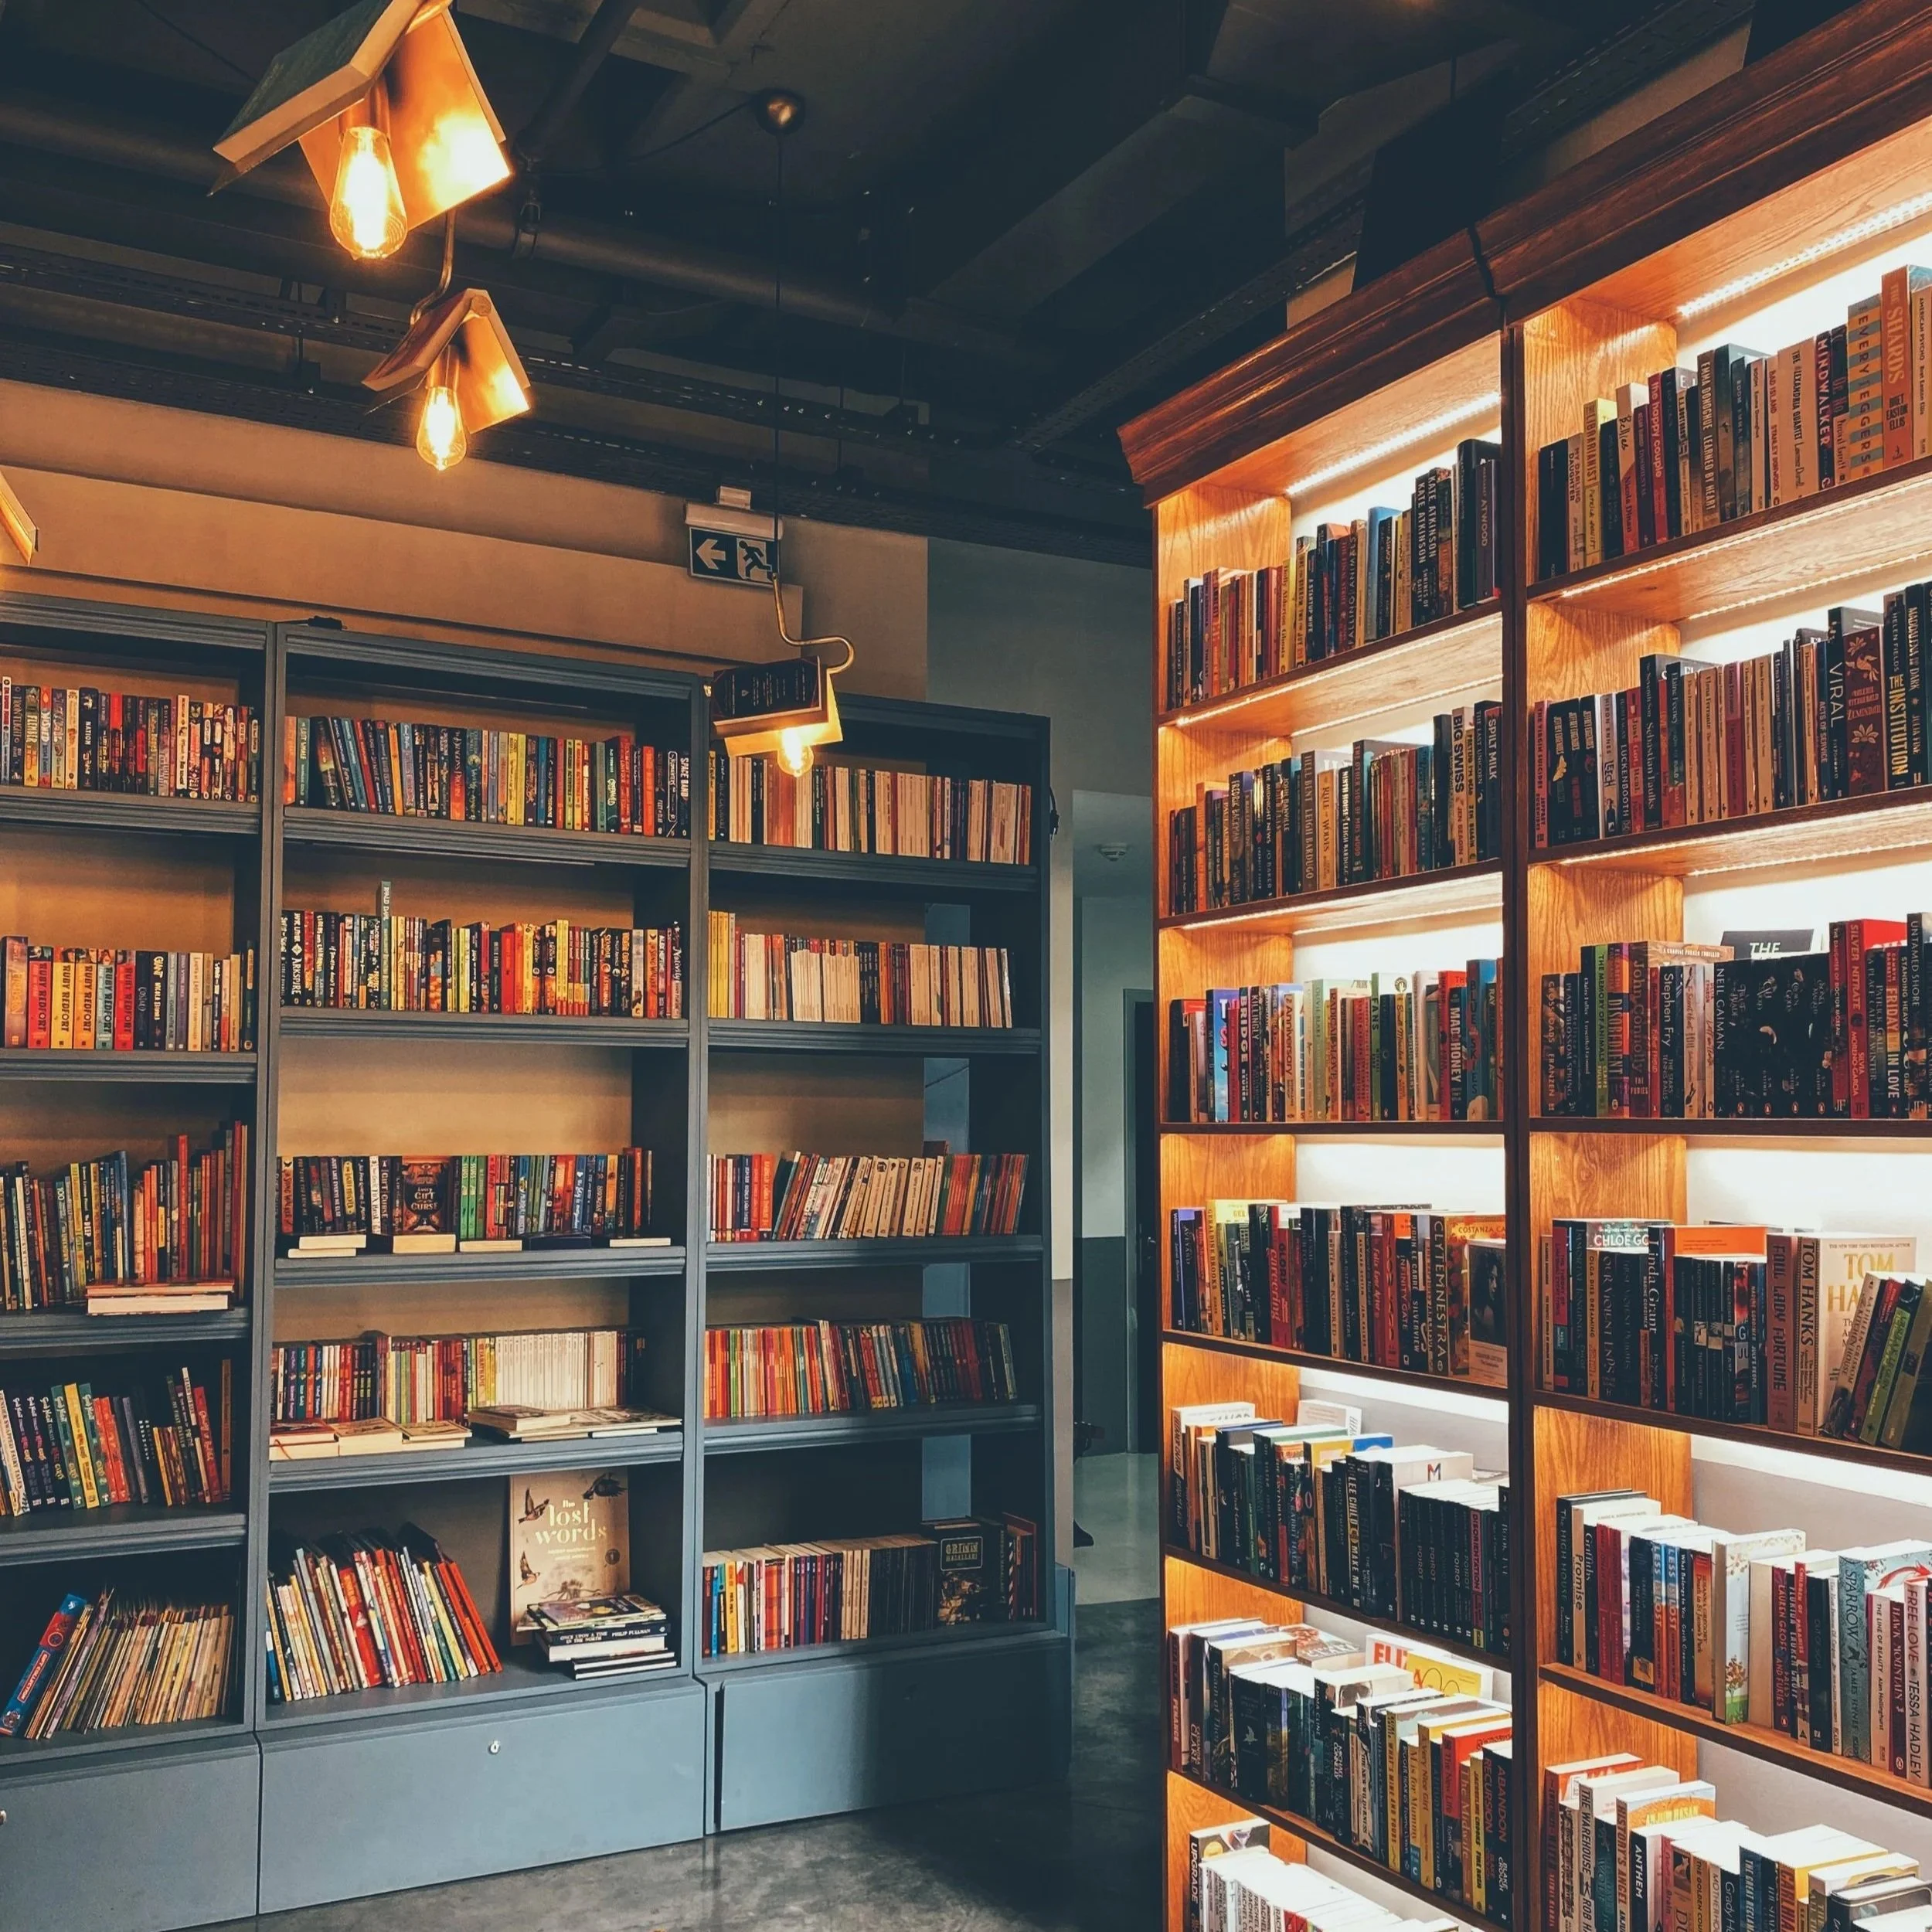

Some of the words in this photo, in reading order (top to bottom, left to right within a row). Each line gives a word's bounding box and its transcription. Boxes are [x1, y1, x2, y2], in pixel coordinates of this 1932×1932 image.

[1859, 315, 1870, 373] EVERY
[1886, 308, 1904, 384] SHARDS
[1818, 339, 1831, 447] MINDWALKER
[1859, 391, 1871, 462] EGGERS
[1889, 419, 1906, 430] ELLIS
[1653, 440, 1662, 477] couple
[1417, 482, 1426, 508] KATE
[1428, 475, 1437, 501] KATE
[1418, 512, 1427, 564] ATKINSON
[1428, 505, 1437, 558] ATKINSON
[1829, 662, 1845, 728] VIRAL
[1889, 674, 1904, 688] THE
[1454, 716, 1462, 741] BIG
[1889, 688, 1909, 775] INSTITUTION
[1454, 745, 1464, 793] SWISS
[1488, 752, 1497, 779] MILK
[1621, 745, 1630, 817] LUCKENBOOTH
[1750, 942, 1781, 954] THE
[1850, 924, 1859, 961] SILVER
[1911, 921, 1920, 971] UNTAMED
[84, 965, 93, 989] RUBY
[104, 967, 113, 992] RUBY
[291, 957, 301, 995] ARKSPIRE
[1632, 961, 1642, 999] John
[1852, 966, 1861, 1011] NITRATE
[38, 991, 47, 1032] REDFORT
[62, 992, 70, 1032] REDFORT
[83, 992, 92, 1032] REDFORT
[104, 993, 112, 1034] REDFORT
[1664, 973, 1674, 1023] Stephen
[1886, 988, 1899, 1032] FRIDAY
[1284, 1006, 1293, 1076] Anniversary
[1632, 1005, 1644, 1073] Connolly
[1662, 1028, 1674, 1047] Fry
[1451, 1042, 1461, 1083] HONEY
[1888, 1052, 1899, 1066] IN
[1888, 1070, 1900, 1098] LOVE
[1594, 1235, 1631, 1246] CHLOE
[1803, 1243, 1815, 1276] TOM
[1649, 1241, 1658, 1283] Linda
[1270, 1249, 1280, 1321] careering
[1434, 1220, 1447, 1357] CLYTEMNESTRA
[1649, 1288, 1659, 1334] Grant
[1801, 1286, 1814, 1346] HANKS
[1773, 1327, 1787, 1391] FORTUNE
[536, 1519, 607, 1545] words
[549, 1502, 590, 1526] lost
[1472, 1514, 1481, 1590] DISORIENTATION
[1352, 1575, 1359, 1590] ME
[1845, 1571, 1858, 1643] SPARROW
[1907, 1589, 1917, 1621] FREE
[1877, 1635, 1883, 1645] OF
[1908, 1626, 1919, 1663] LOVE
[1909, 1679, 1920, 1718] TESSA
[1910, 1722, 1920, 1779] HADLEY
[1484, 1758, 1493, 1833] RECURSION
[1497, 1765, 1507, 1842] ABANDON
[1580, 1790, 1590, 1808] THE
[1581, 1812, 1591, 1876] WAREHOUSE
[1583, 1900, 1592, 1918] ROB
[1617, 1872, 1628, 1910] ANGEL
[1725, 1882, 1735, 1919] Grady
